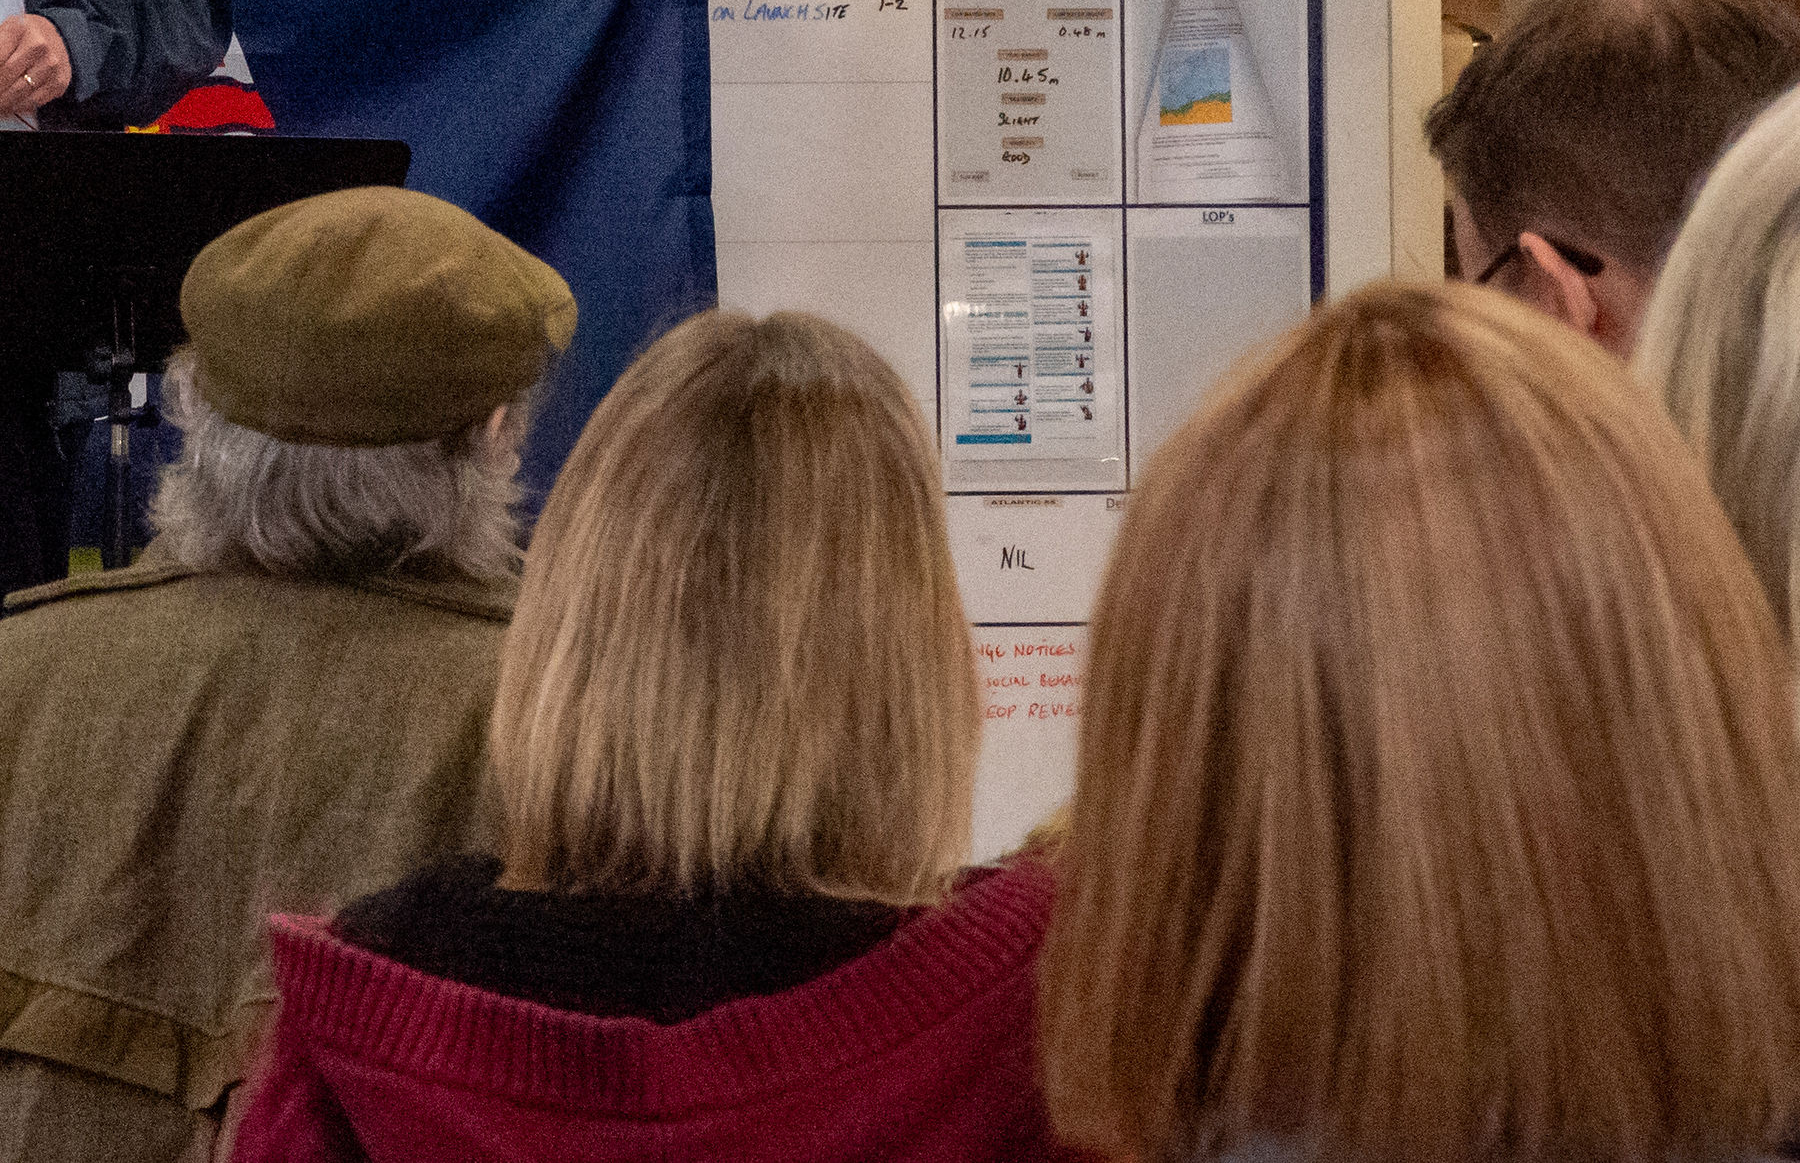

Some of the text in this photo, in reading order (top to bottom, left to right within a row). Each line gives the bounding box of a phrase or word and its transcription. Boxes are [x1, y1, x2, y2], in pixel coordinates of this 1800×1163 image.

[815, 4, 850, 20] SITE
[952, 25, 991, 39] 12.15
[1202, 211, 1234, 223] LOP's
[1001, 545, 1035, 570] NIL
[1014, 642, 1076, 658] NOTICES
